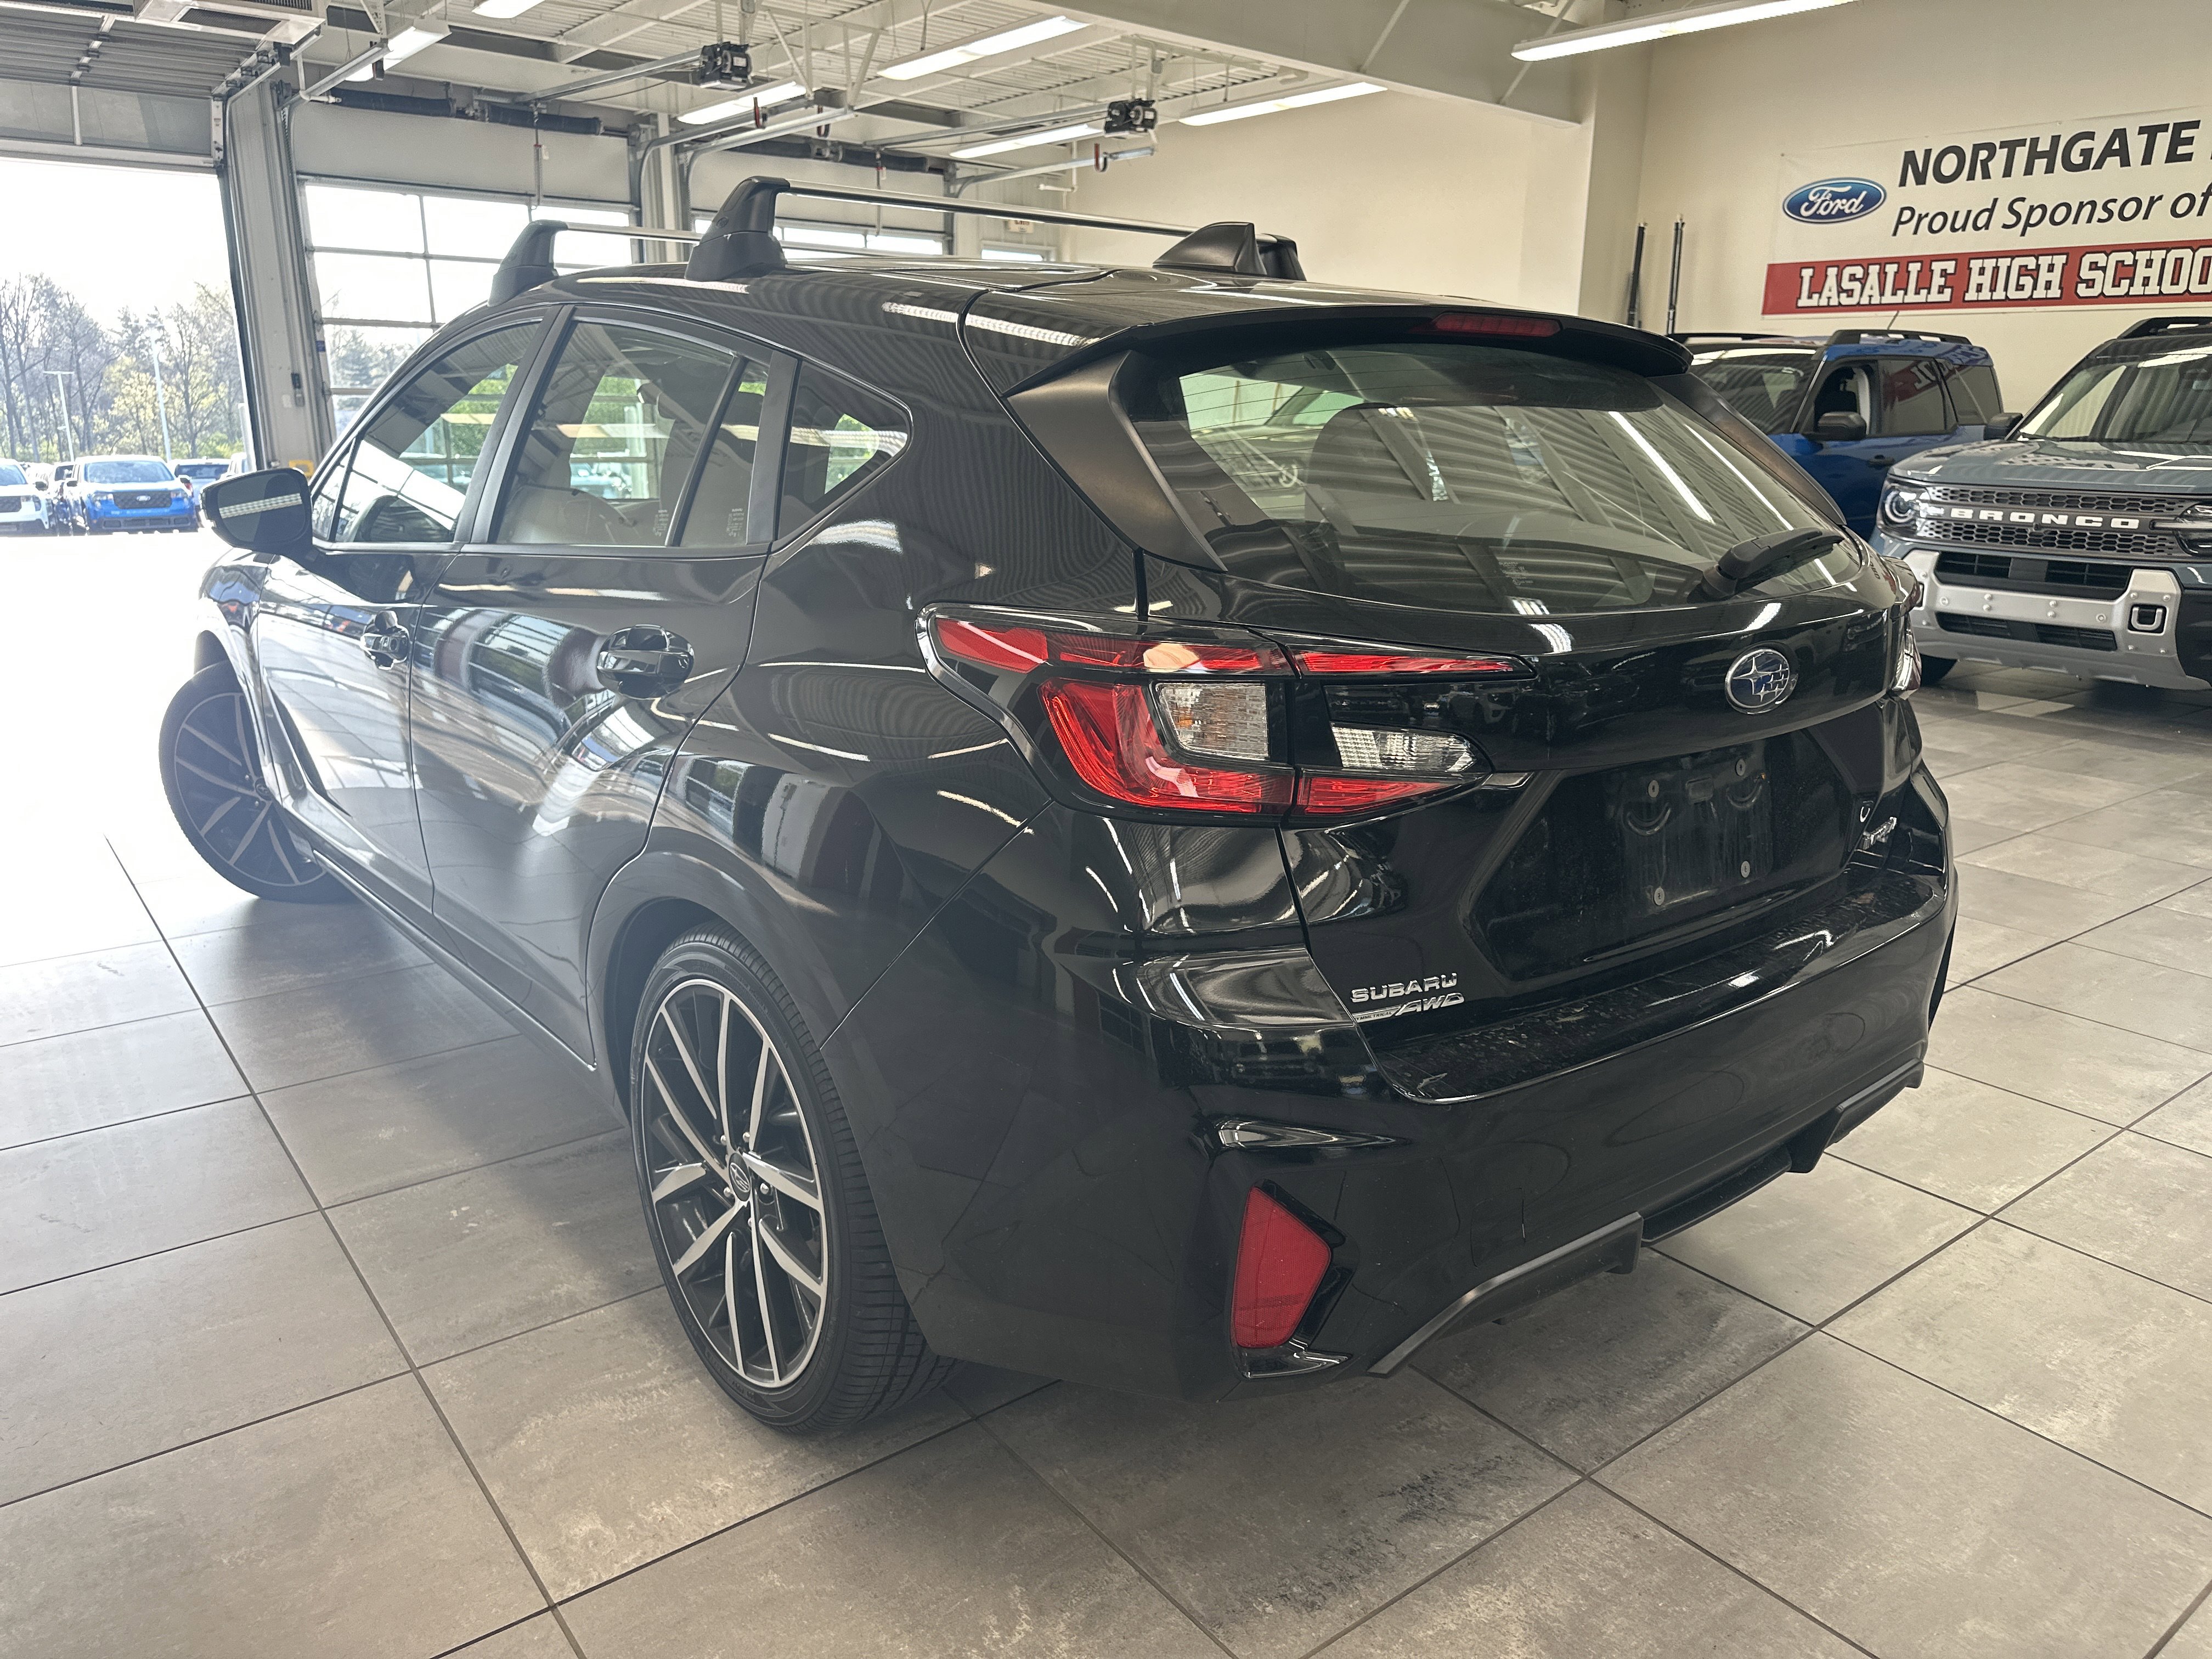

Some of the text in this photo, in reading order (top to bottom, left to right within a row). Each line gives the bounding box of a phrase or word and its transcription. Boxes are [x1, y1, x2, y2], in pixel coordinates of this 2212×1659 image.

[1898, 119, 2201, 188] NORTHGATE
[1800, 185, 1867, 217] Ford
[1892, 182, 2212, 236] Proud Sponsor of
[1797, 259, 1957, 308] LASALLE
[1963, 253, 2069, 301] HIGH
[1950, 508, 2140, 529] BRONCO
[1351, 973, 1457, 1003] SUBARU
[1395, 992, 1464, 1016] AWD
